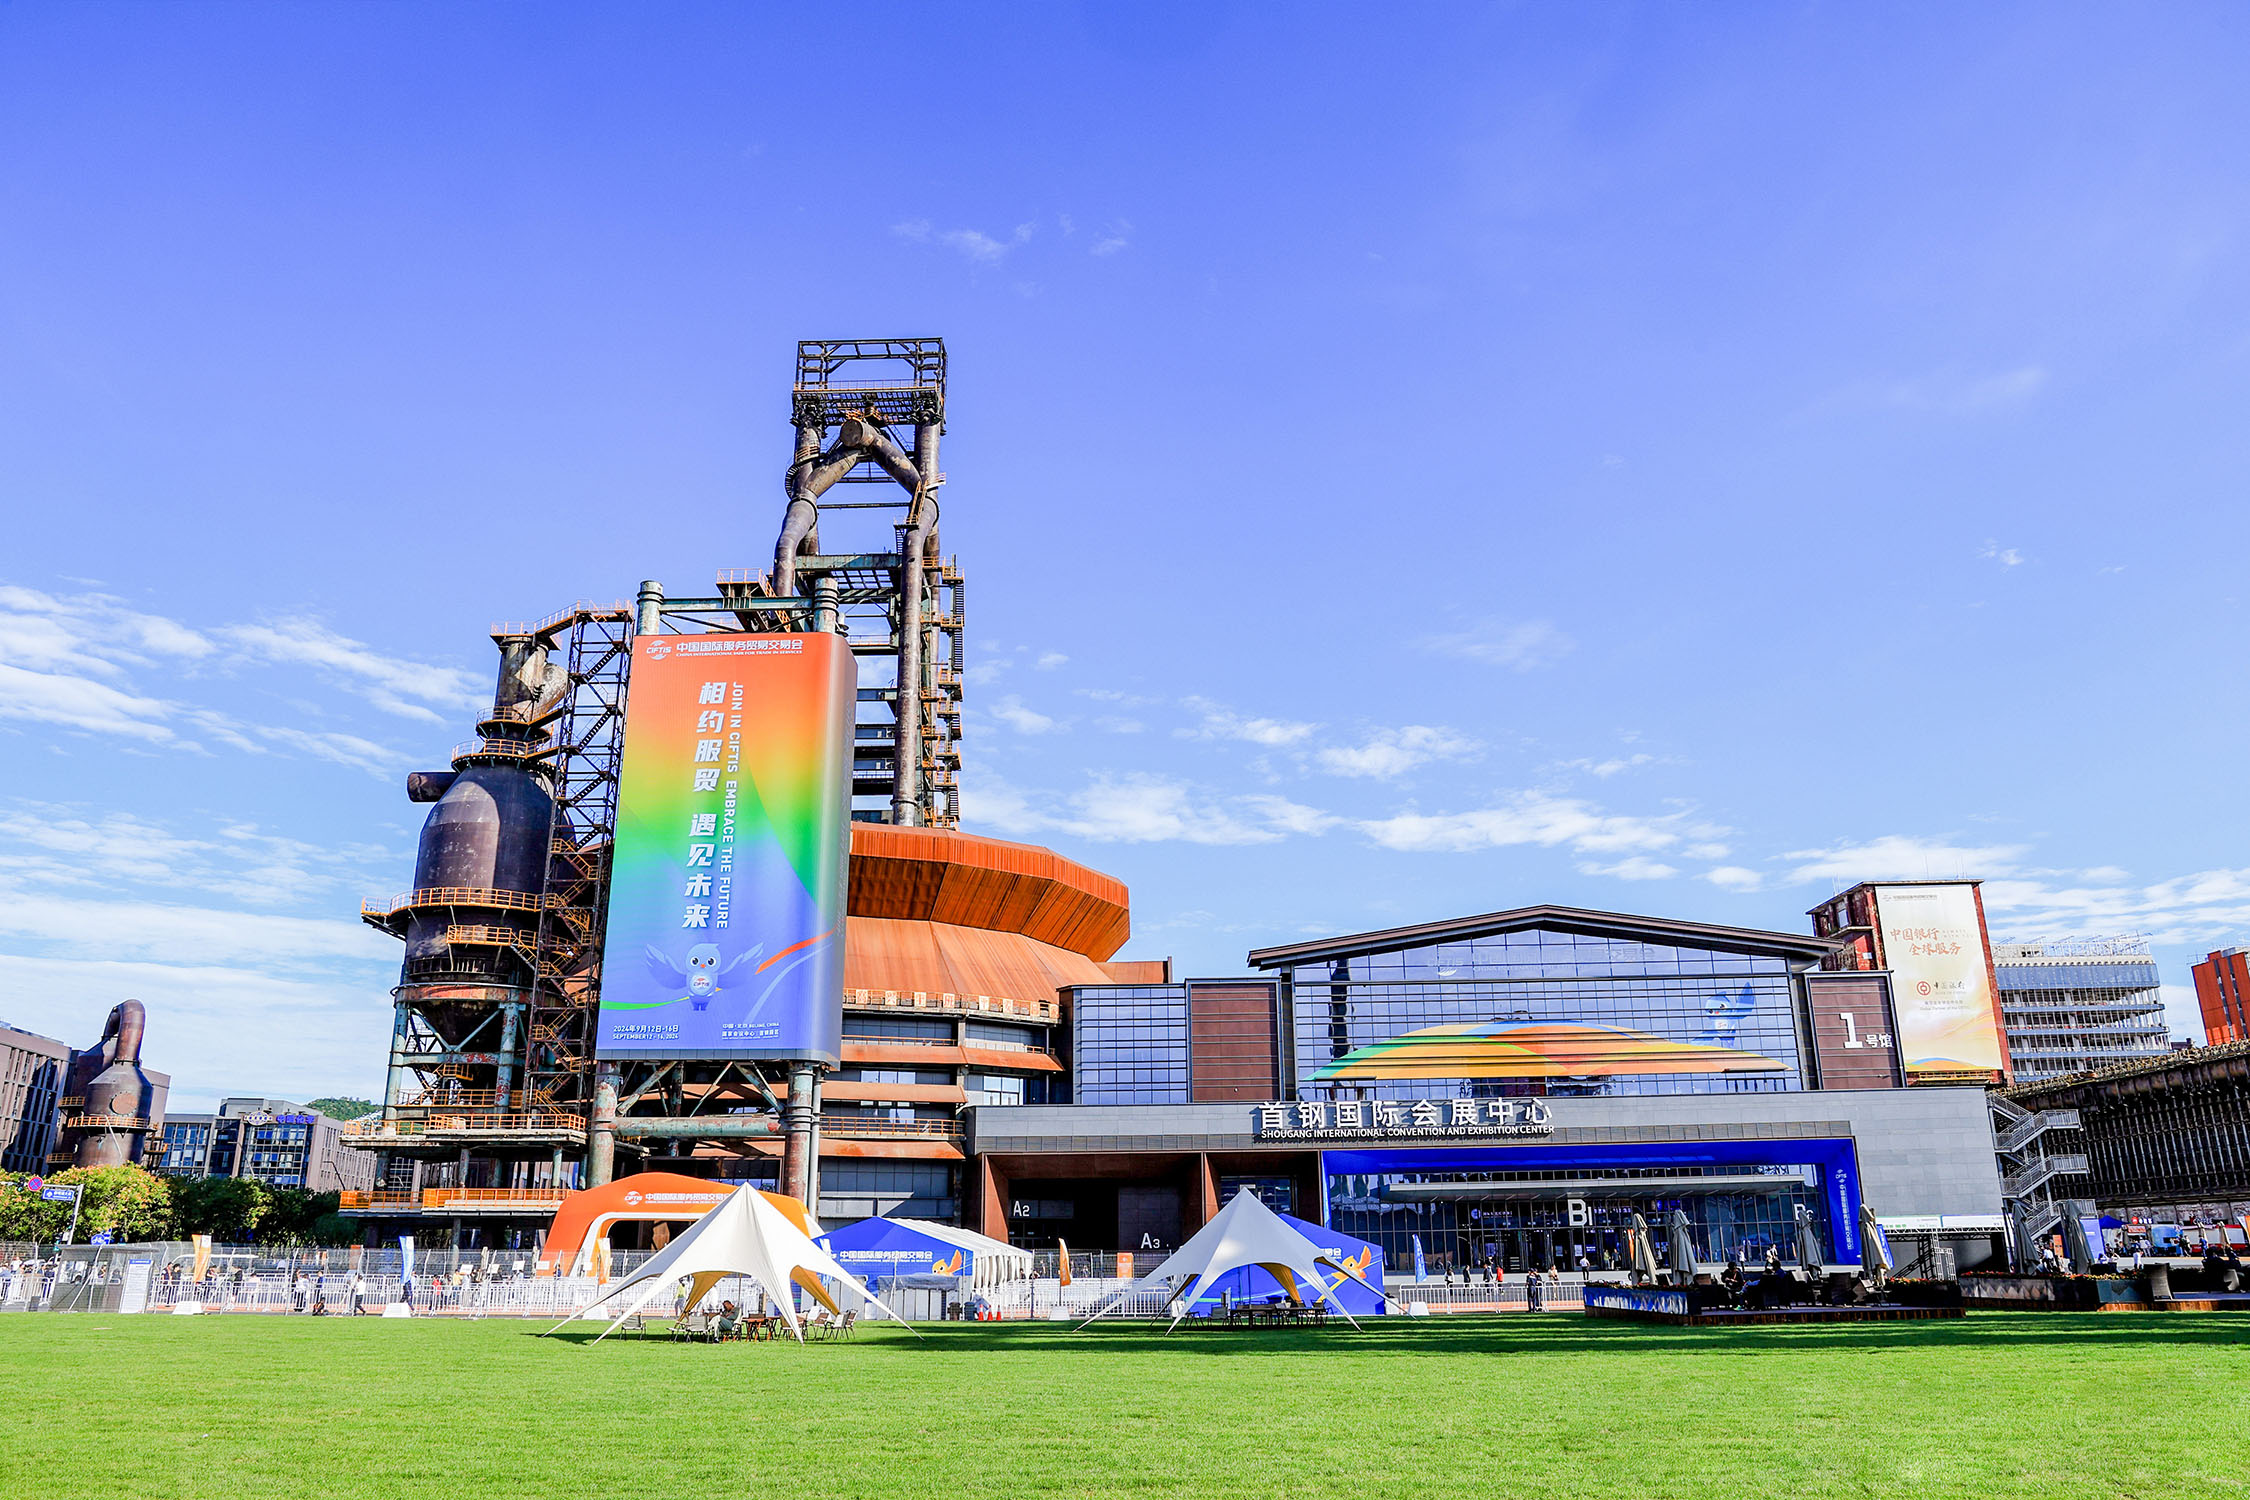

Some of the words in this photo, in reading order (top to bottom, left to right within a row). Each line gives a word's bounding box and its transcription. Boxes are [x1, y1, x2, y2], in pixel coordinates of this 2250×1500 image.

[676, 639, 803, 652] 中国国际服务贸易交易会
[731, 681, 744, 711] JOIN
[729, 714, 742, 728] IN
[692, 682, 727, 792] 相约服贸
[727, 732, 741, 773] CIFTIS
[723, 780, 738, 843] EMBRACE
[681, 813, 717, 928] 遇见未来
[720, 846, 733, 873] THE
[716, 876, 731, 929] FUTURE
[1890, 927, 1940, 941] 中国银行
[1909, 941, 1961, 956] 全球服务
[613, 1024, 679, 1033] 2024年9月12日-16日
[1257, 1098, 1553, 1129] 首钢国际会展中心
[1261, 1129, 1313, 1139] SHOUGANG
[1313, 1127, 1385, 1138] INTERNATIONAL
[1387, 1127, 1447, 1137] CONVENTION
[1446, 1126, 1468, 1136] AND
[1468, 1125, 1521, 1136] EXHIBITION
[1520, 1125, 1555, 1135] CENTER
[1013, 1200, 1030, 1217] A2
[1140, 1232, 1161, 1249] A3
